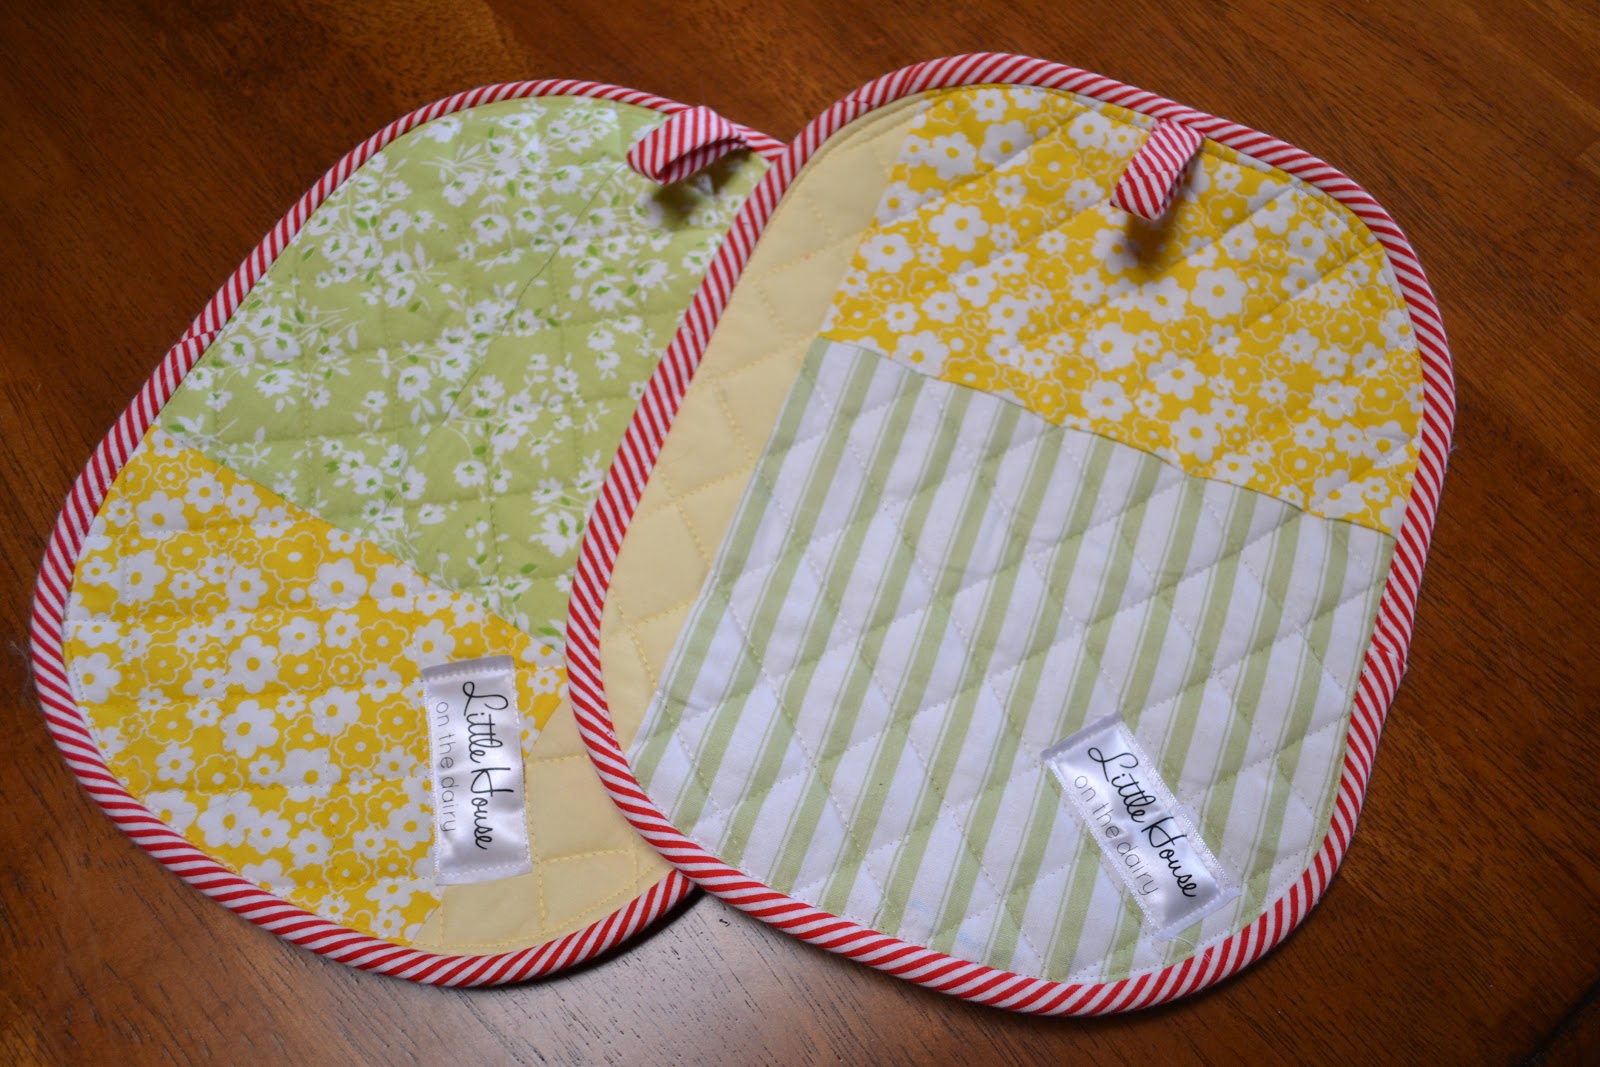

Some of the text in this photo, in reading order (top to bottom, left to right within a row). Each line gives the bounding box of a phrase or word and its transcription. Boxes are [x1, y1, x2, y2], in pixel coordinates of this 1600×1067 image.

[435, 701, 459, 832] on the dairy
[462, 681, 514, 850] Little House
[1074, 775, 1159, 896] on the dairy
[1087, 747, 1197, 898] Little House
